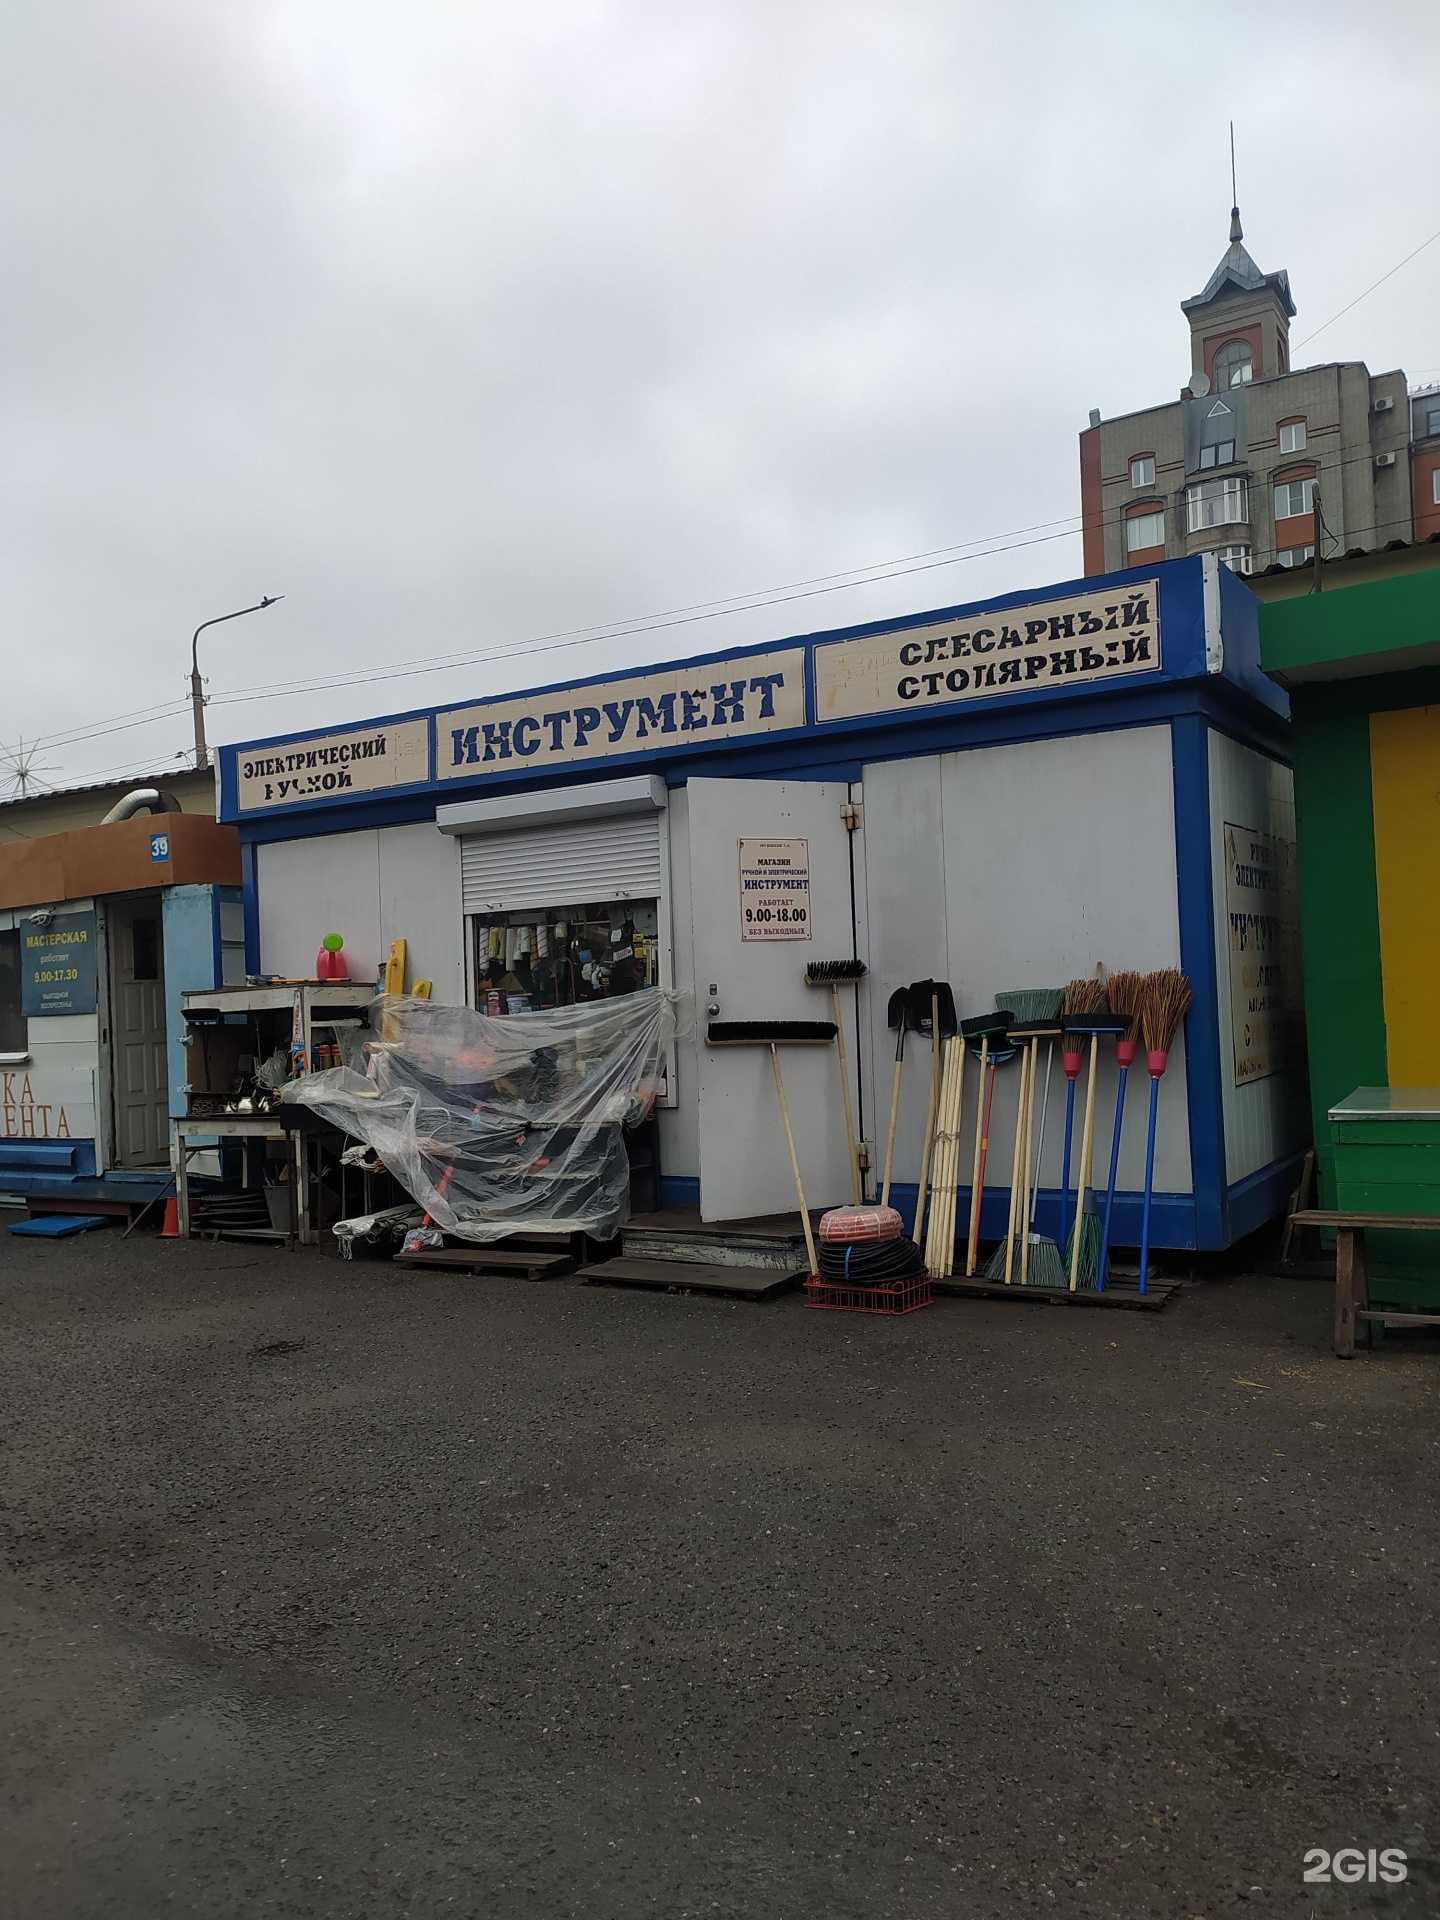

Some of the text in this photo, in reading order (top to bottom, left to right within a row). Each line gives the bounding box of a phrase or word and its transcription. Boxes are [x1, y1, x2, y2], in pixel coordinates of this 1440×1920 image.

[899, 593, 1150, 666] СЛЕСАРНЫЙ
[897, 629, 1151, 700] СТОЛЯРНЫЙ
[450, 672, 785, 766] ИНСТРУМЕНТ
[243, 734, 387, 779] ЭЛЕКТРИЧЕСКИЙ
[151, 838, 168, 856] 39
[744, 879, 809, 890] ИНСТРУМЕНТ
[758, 899, 794, 907] РАБОТАЕТ
[745, 908, 807, 923] 9.00-18.00
[26, 930, 88, 948] МАСТЕРСКАЯ
[748, 927, 806, 936] БЕЗ ВЫХОДНЫХ
[0, 1105, 72, 1138] ЕНТА
